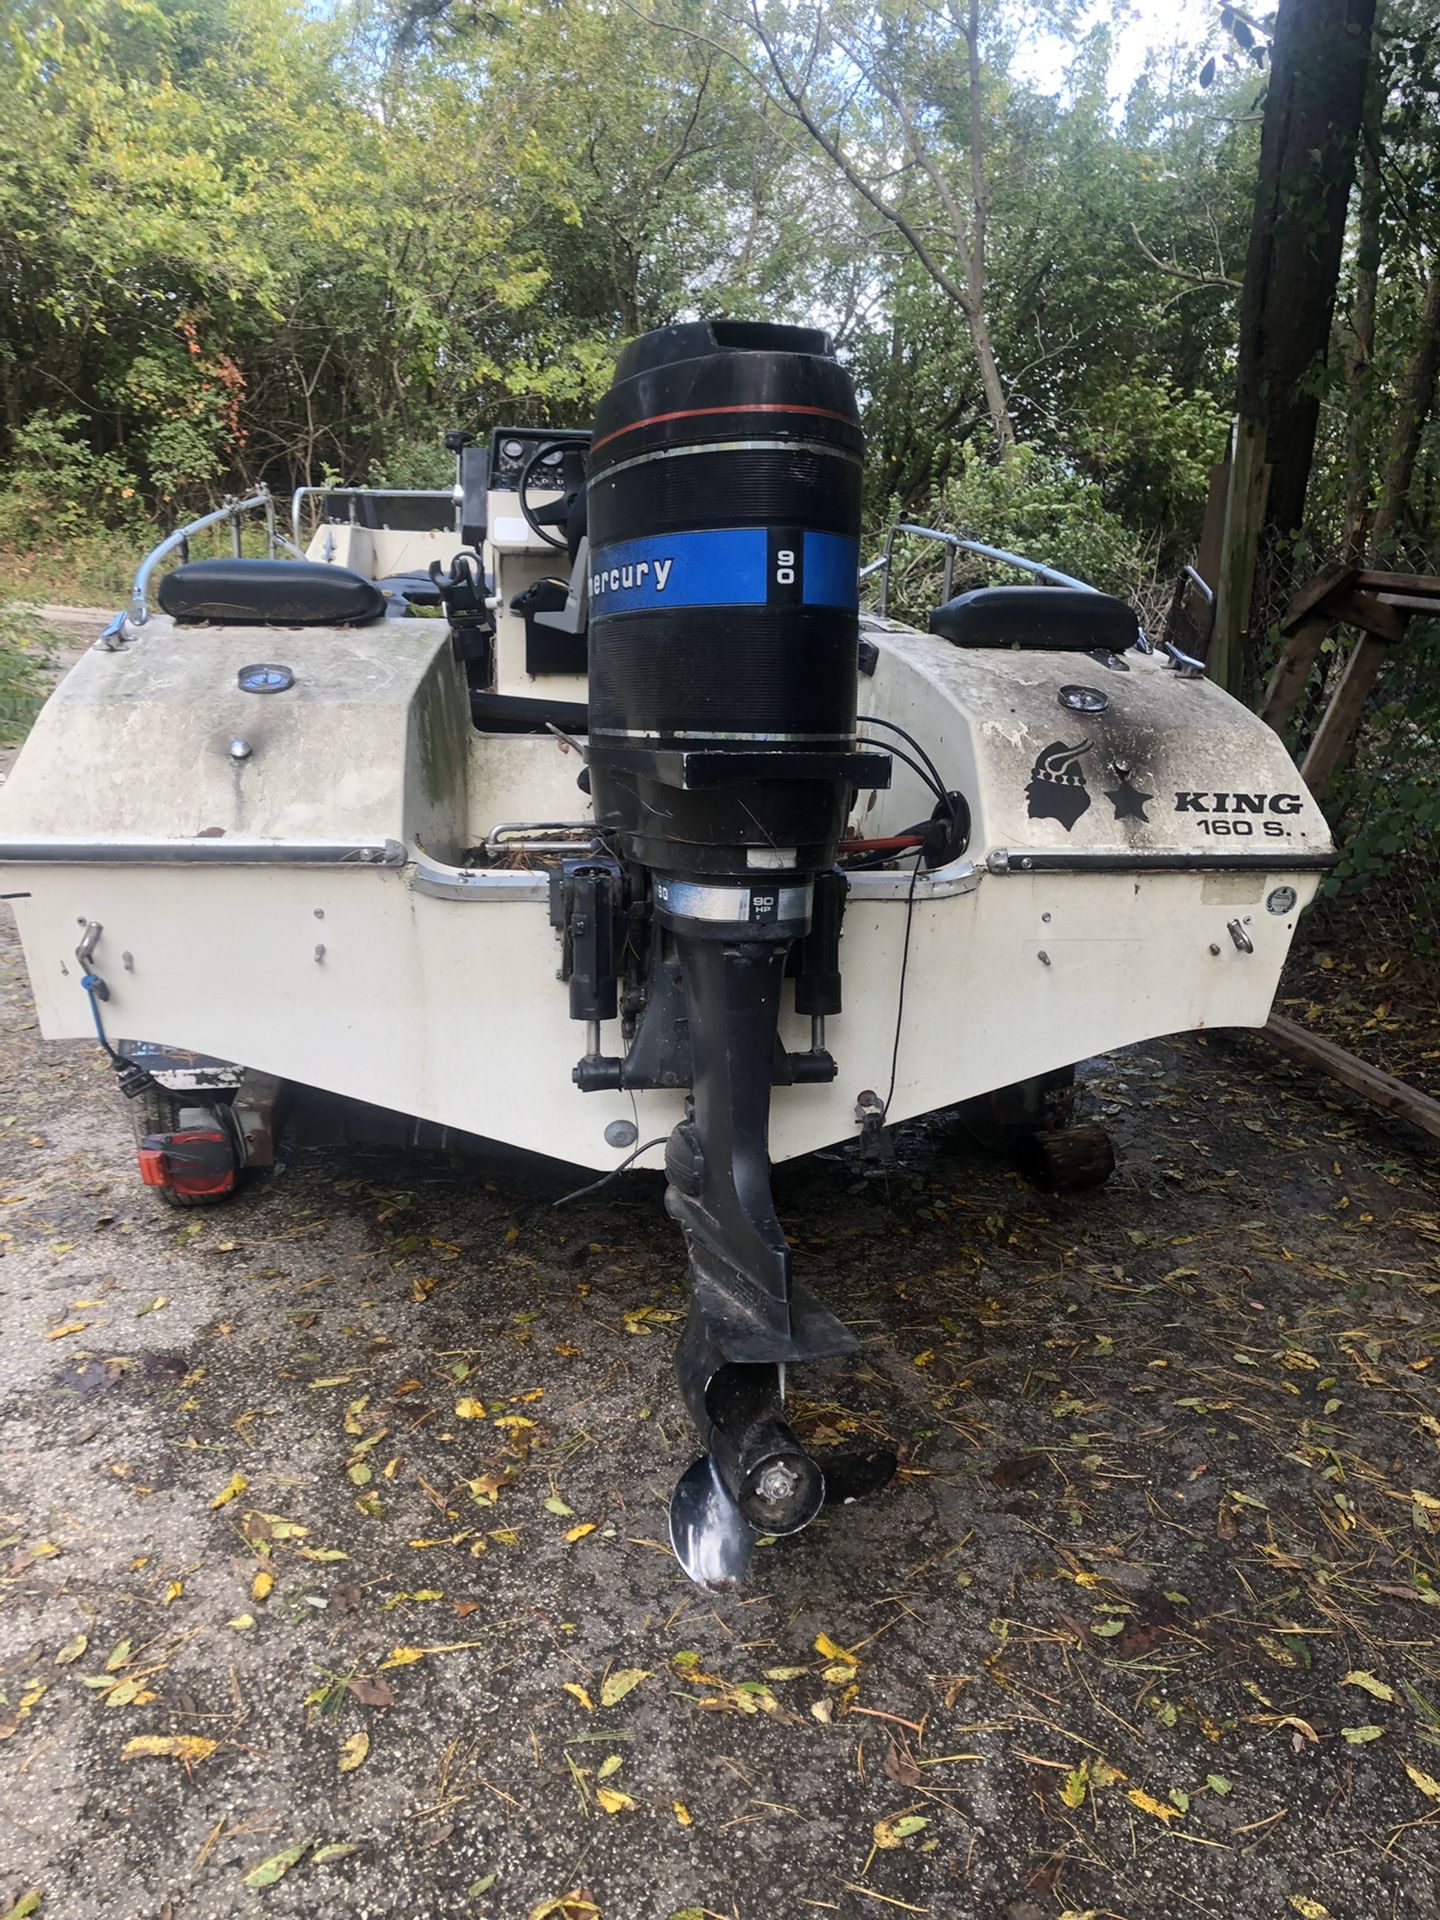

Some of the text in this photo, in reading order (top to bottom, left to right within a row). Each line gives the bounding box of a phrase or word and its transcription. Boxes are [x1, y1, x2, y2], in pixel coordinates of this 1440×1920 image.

[1174, 792, 1303, 814] KING
[1197, 820, 1253, 835] 160
[753, 897, 774, 905] 90
